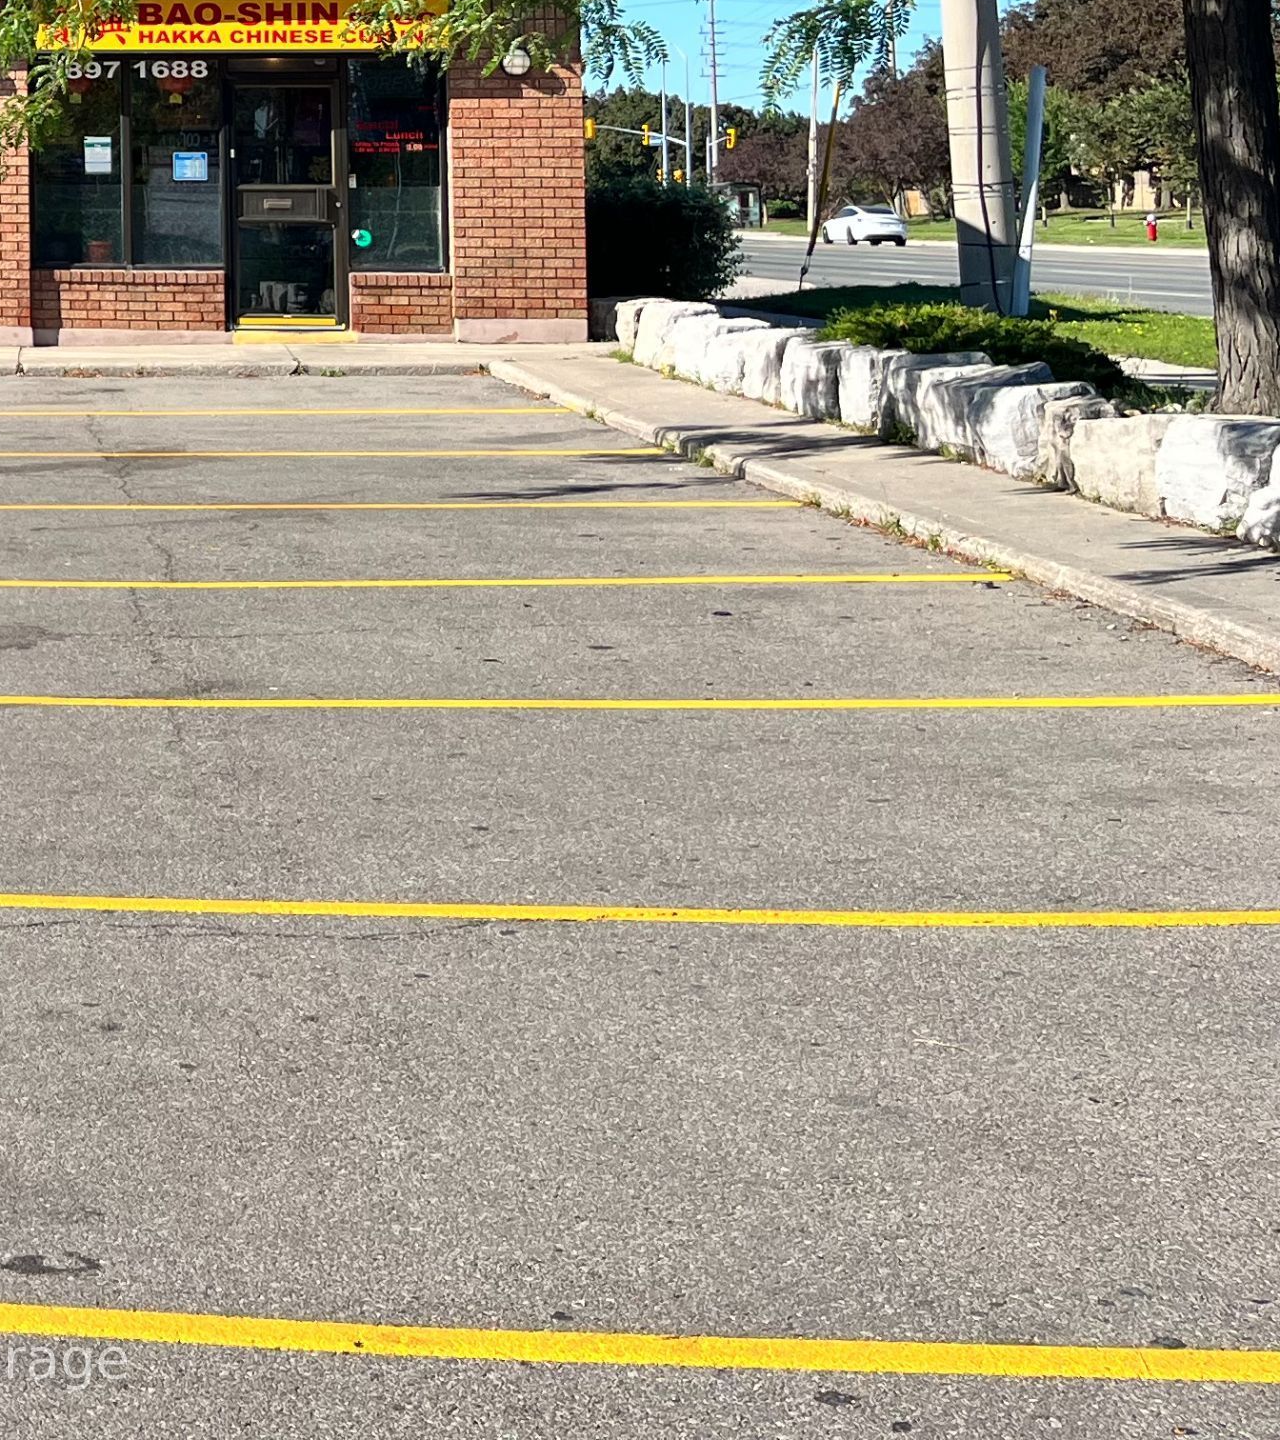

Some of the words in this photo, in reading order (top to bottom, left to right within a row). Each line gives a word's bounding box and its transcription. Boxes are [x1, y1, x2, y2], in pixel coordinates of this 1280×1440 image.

[138, 2, 338, 26] BAO-SHIN
[139, 30, 221, 44] HAKKA
[230, 30, 334, 43] CHINESE
[132, 60, 208, 78] 1688
